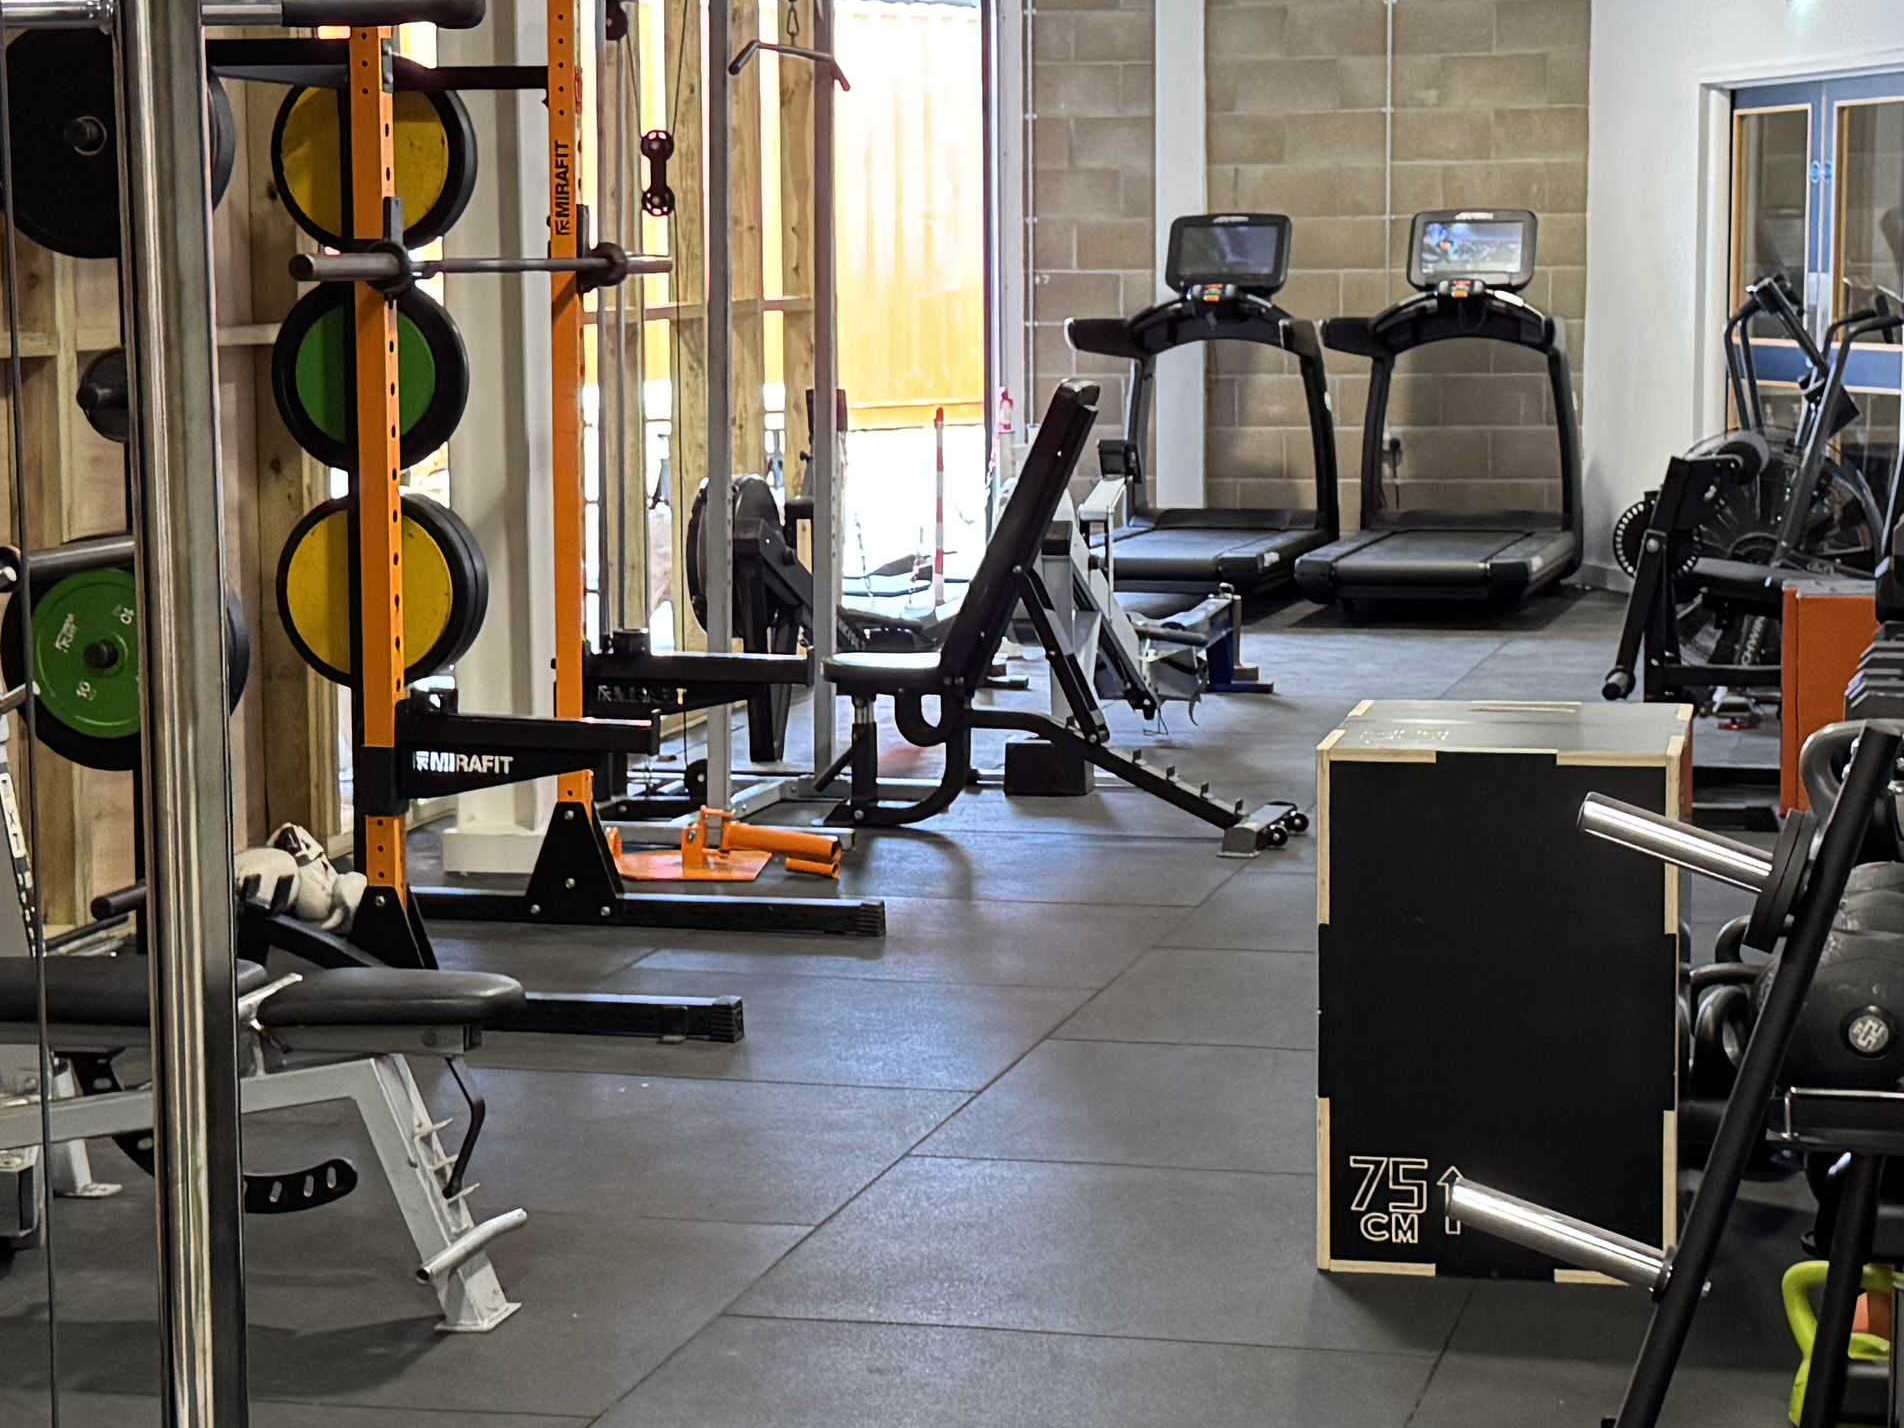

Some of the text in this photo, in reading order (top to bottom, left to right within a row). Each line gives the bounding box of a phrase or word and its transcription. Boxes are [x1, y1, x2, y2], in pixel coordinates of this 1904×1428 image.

[554, 140, 570, 218] MIRAFIT
[429, 751, 514, 774] MIRAFIT
[1349, 1155, 1429, 1214] 75
[1359, 1212, 1419, 1244] CM
